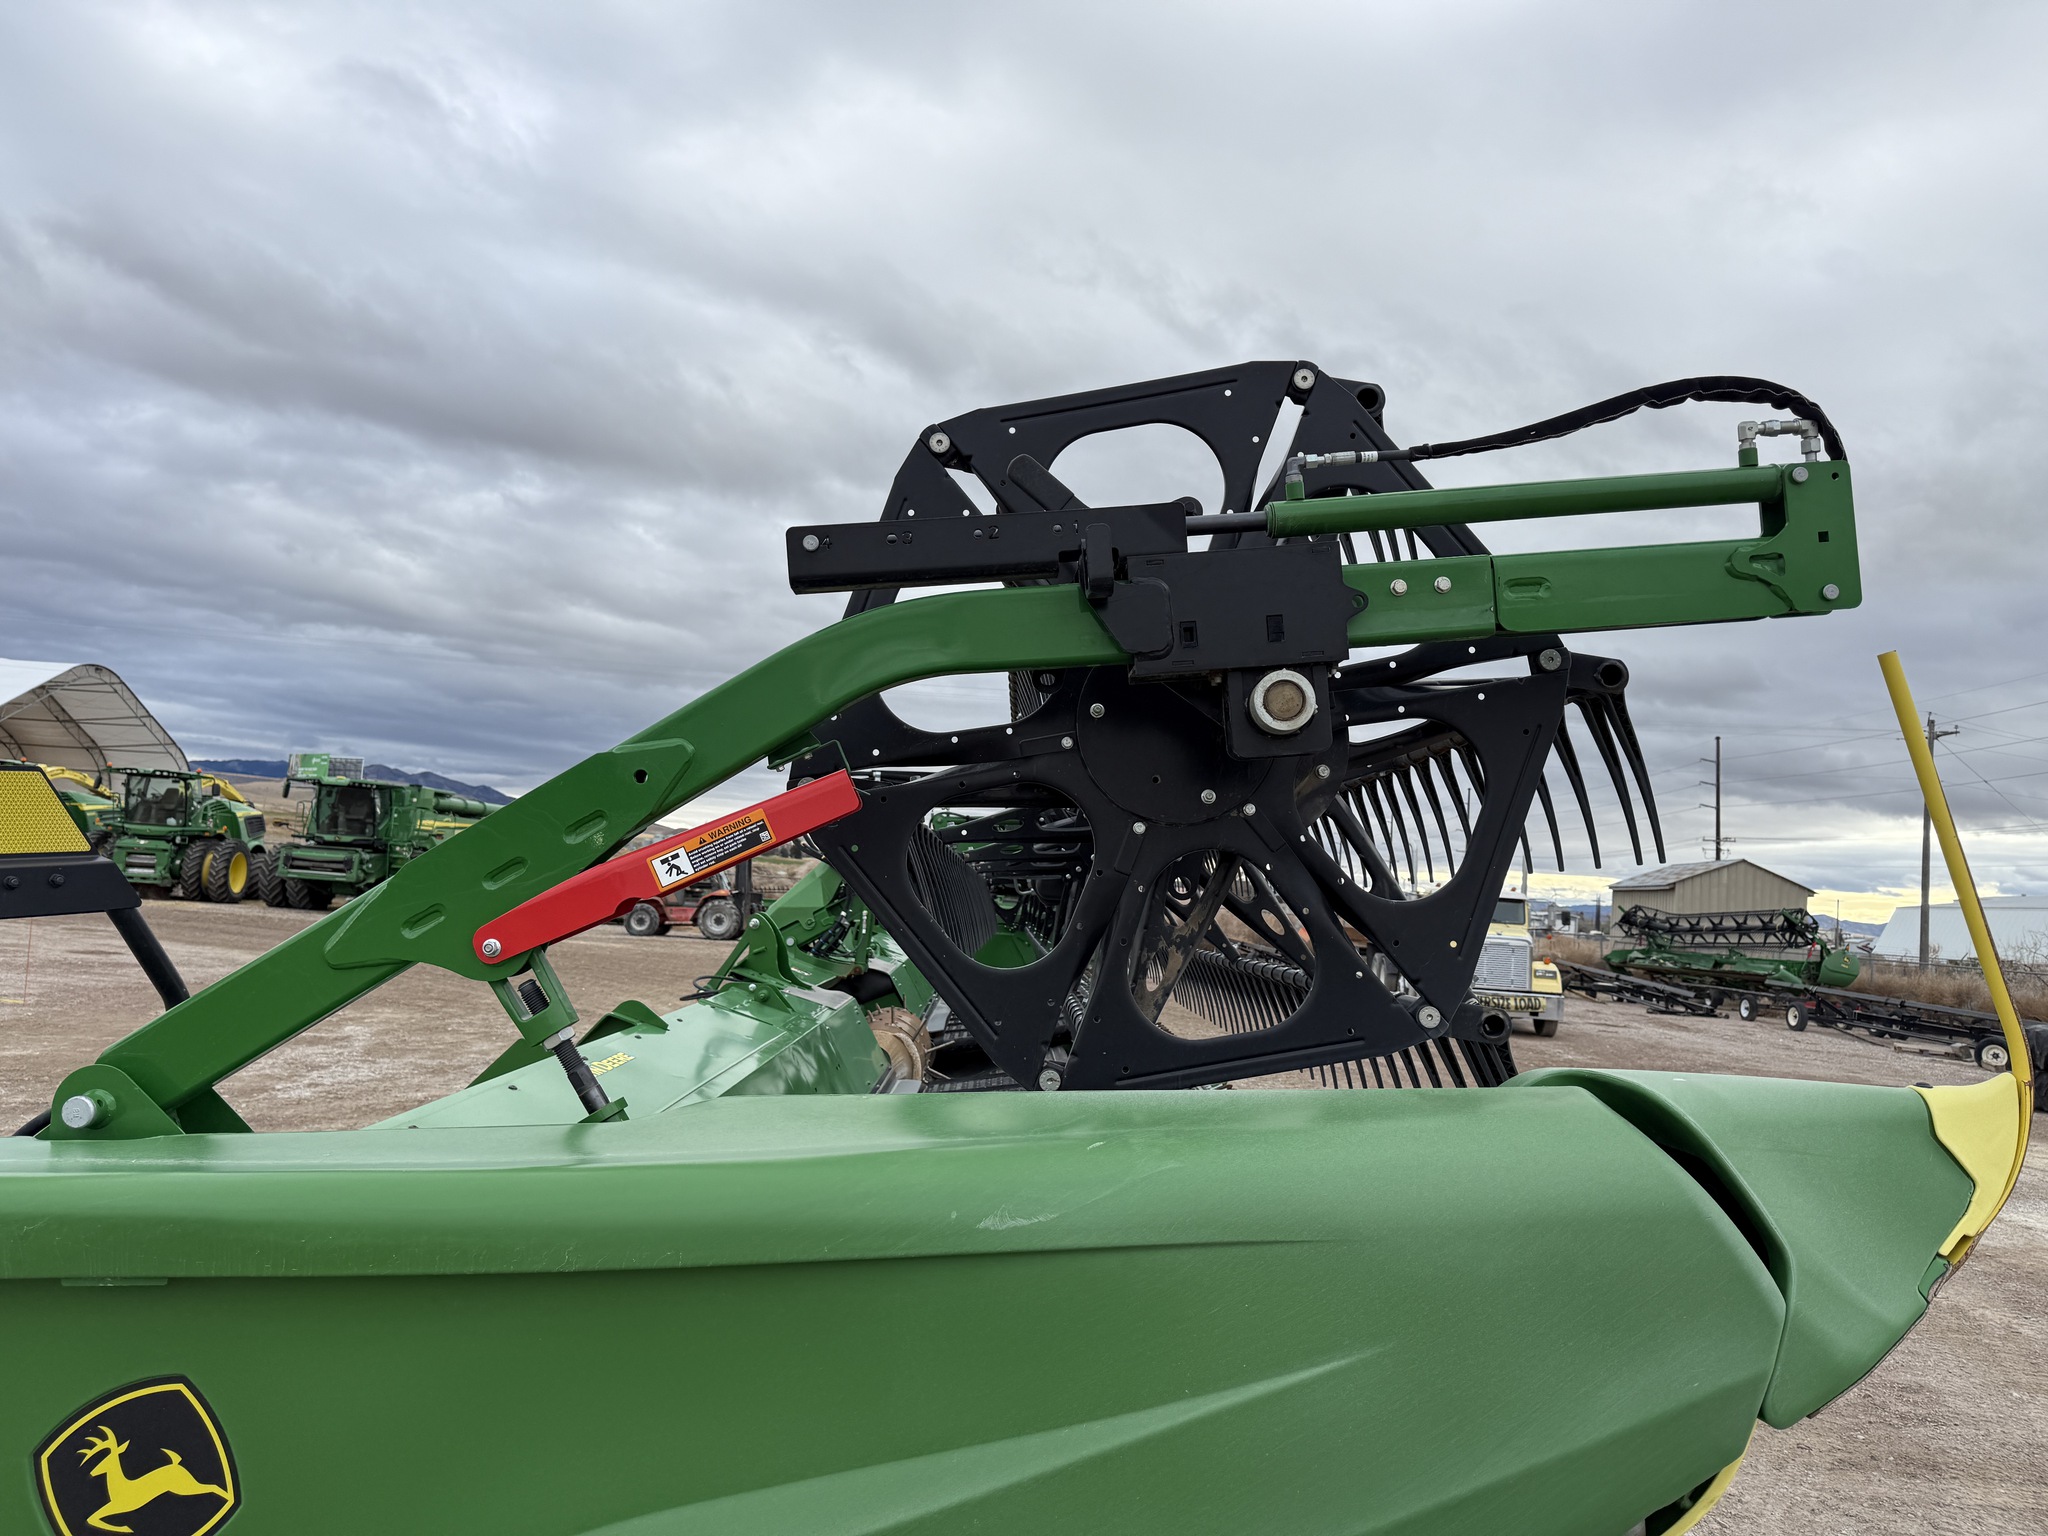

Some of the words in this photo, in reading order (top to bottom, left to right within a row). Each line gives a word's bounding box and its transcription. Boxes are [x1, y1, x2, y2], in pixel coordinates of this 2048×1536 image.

[988, 525, 1000, 540] 2
[1072, 520, 1079, 534] 1
[820, 535, 832, 550] 4
[902, 530, 913, 544] 3
[708, 816, 752, 840] WARNING
[1514, 997, 1542, 1010] LOAD
